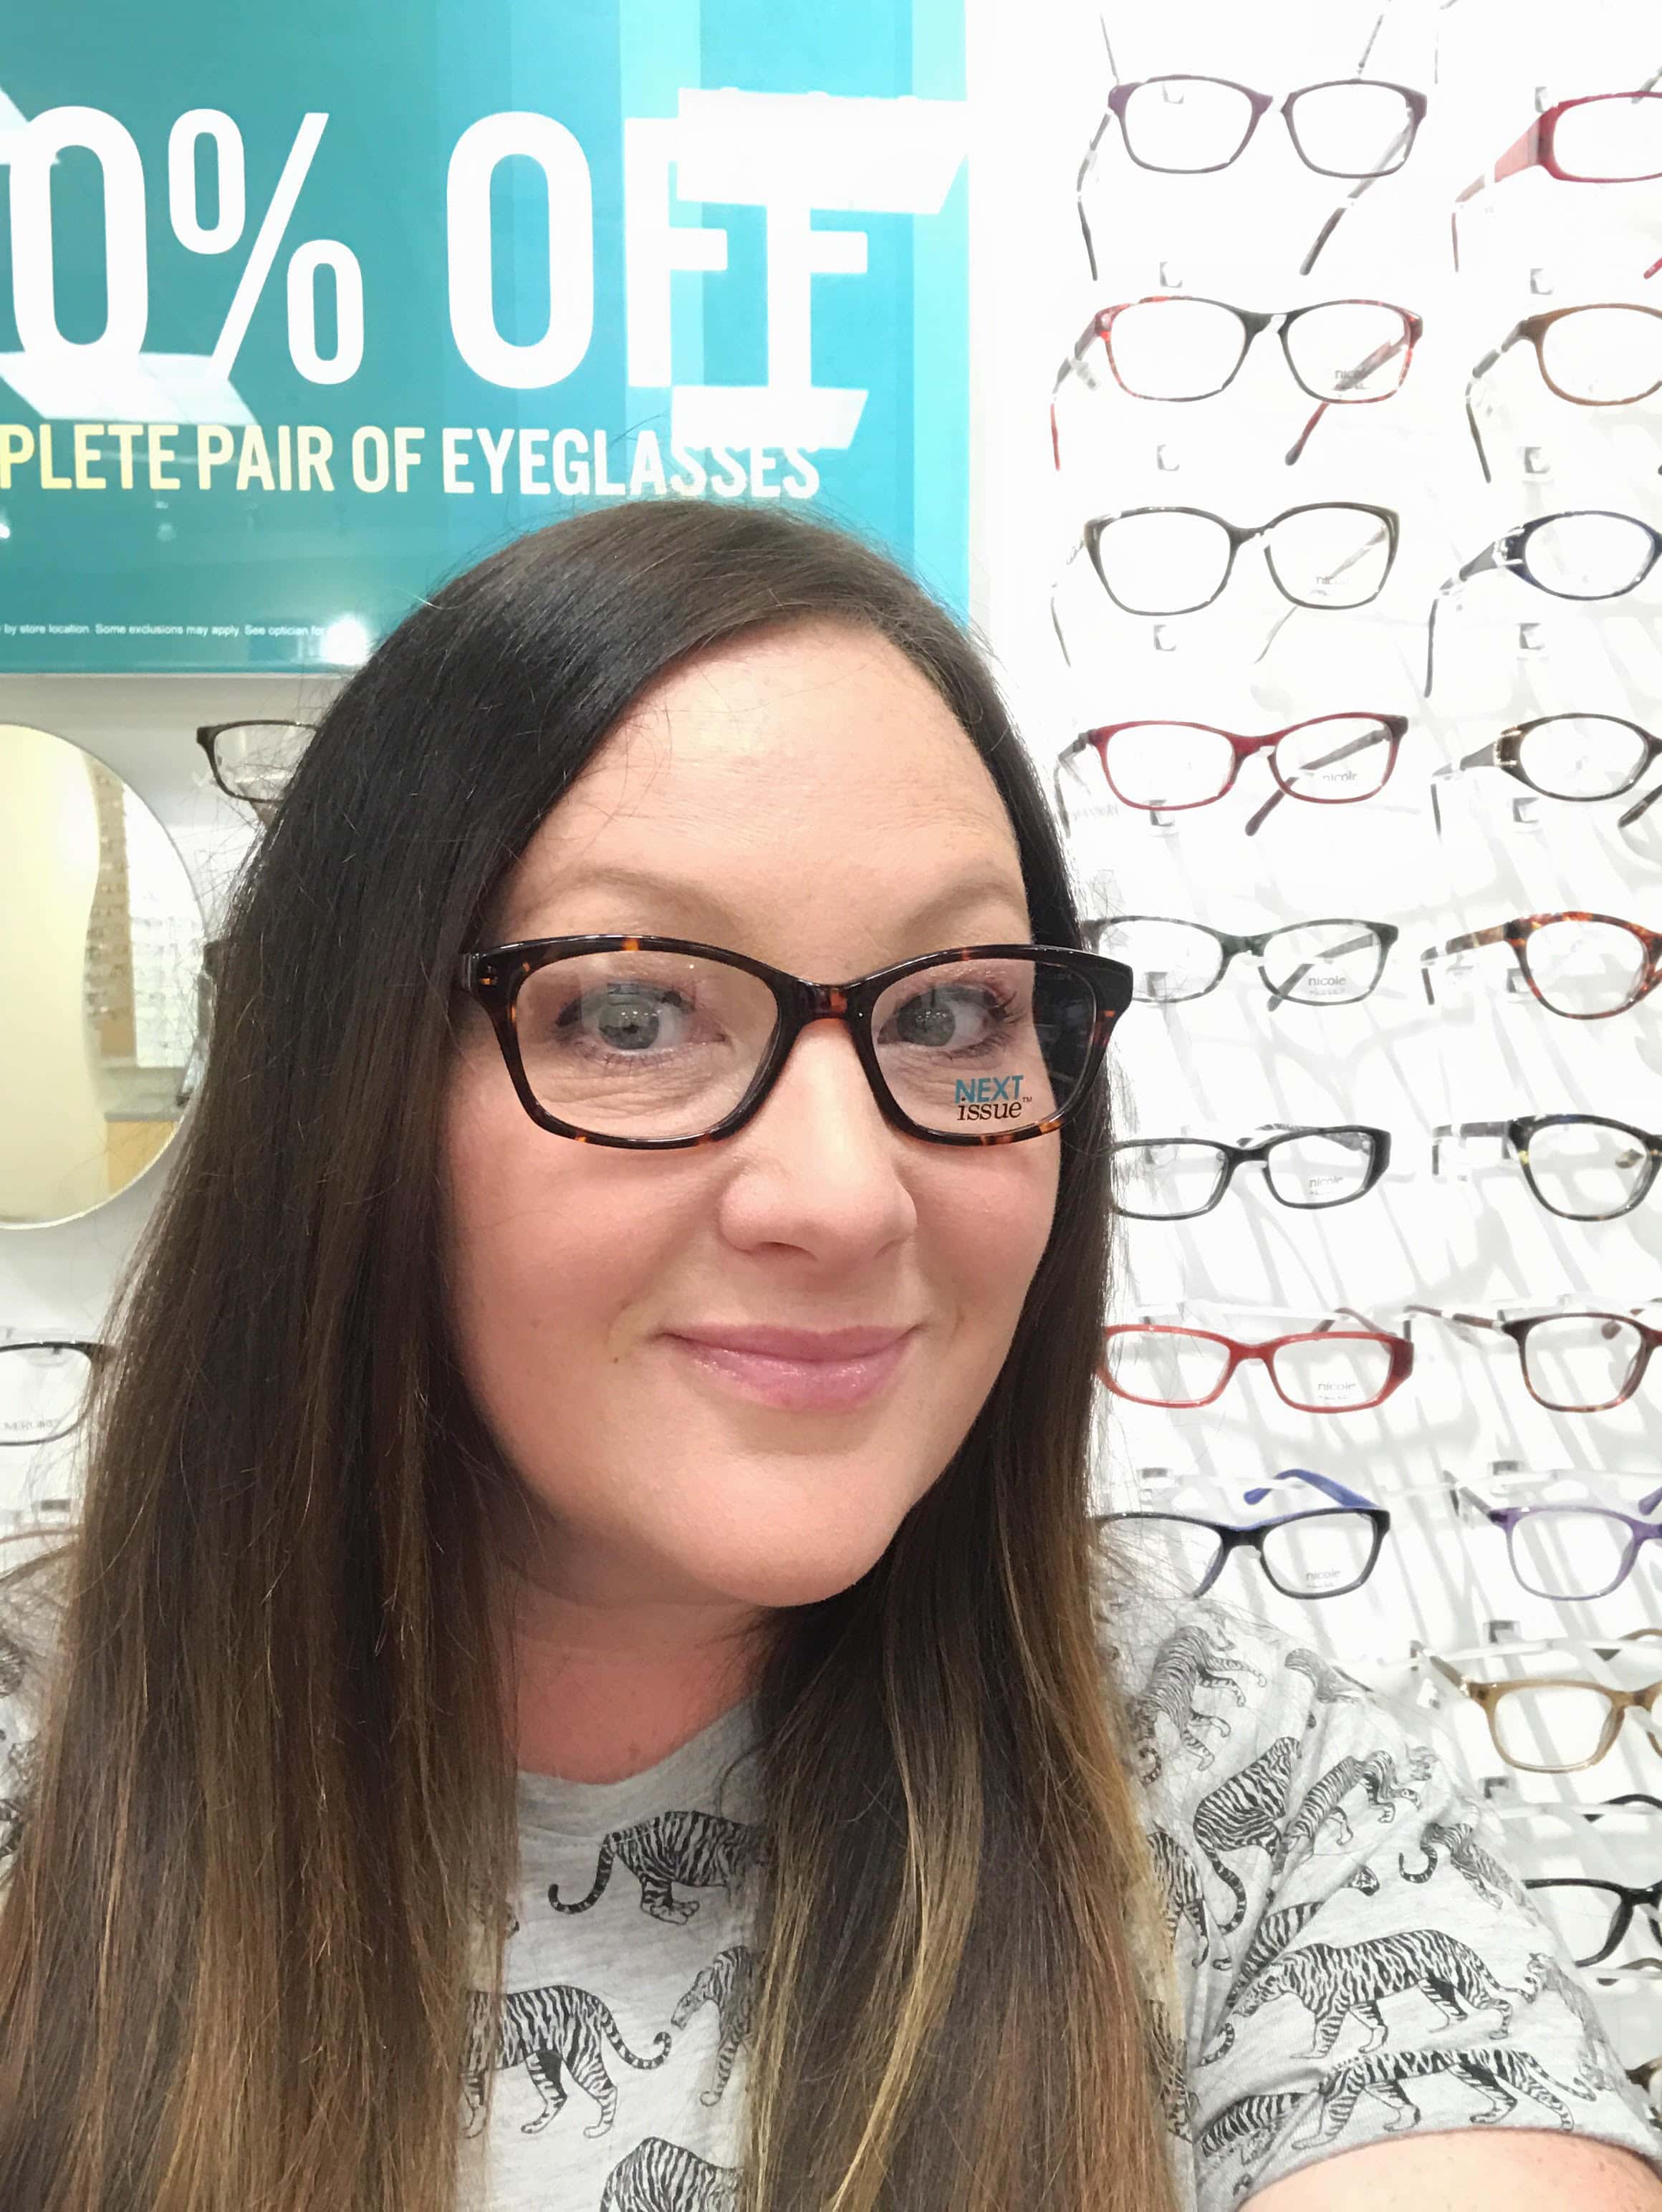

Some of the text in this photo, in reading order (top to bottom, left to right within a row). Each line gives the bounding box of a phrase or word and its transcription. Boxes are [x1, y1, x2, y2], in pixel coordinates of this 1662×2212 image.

[9, 105, 878, 390] 0% OFF
[0, 424, 820, 499] PLETE PAIR OF EYEGLASSES
[19, 624, 46, 635] store
[95, 623, 127, 635] Some
[129, 624, 184, 635] exclusions
[186, 625, 208, 637] may
[244, 624, 266, 635] See
[1308, 976, 1347, 986] nicole
[954, 1074, 1024, 1104] NEXT
